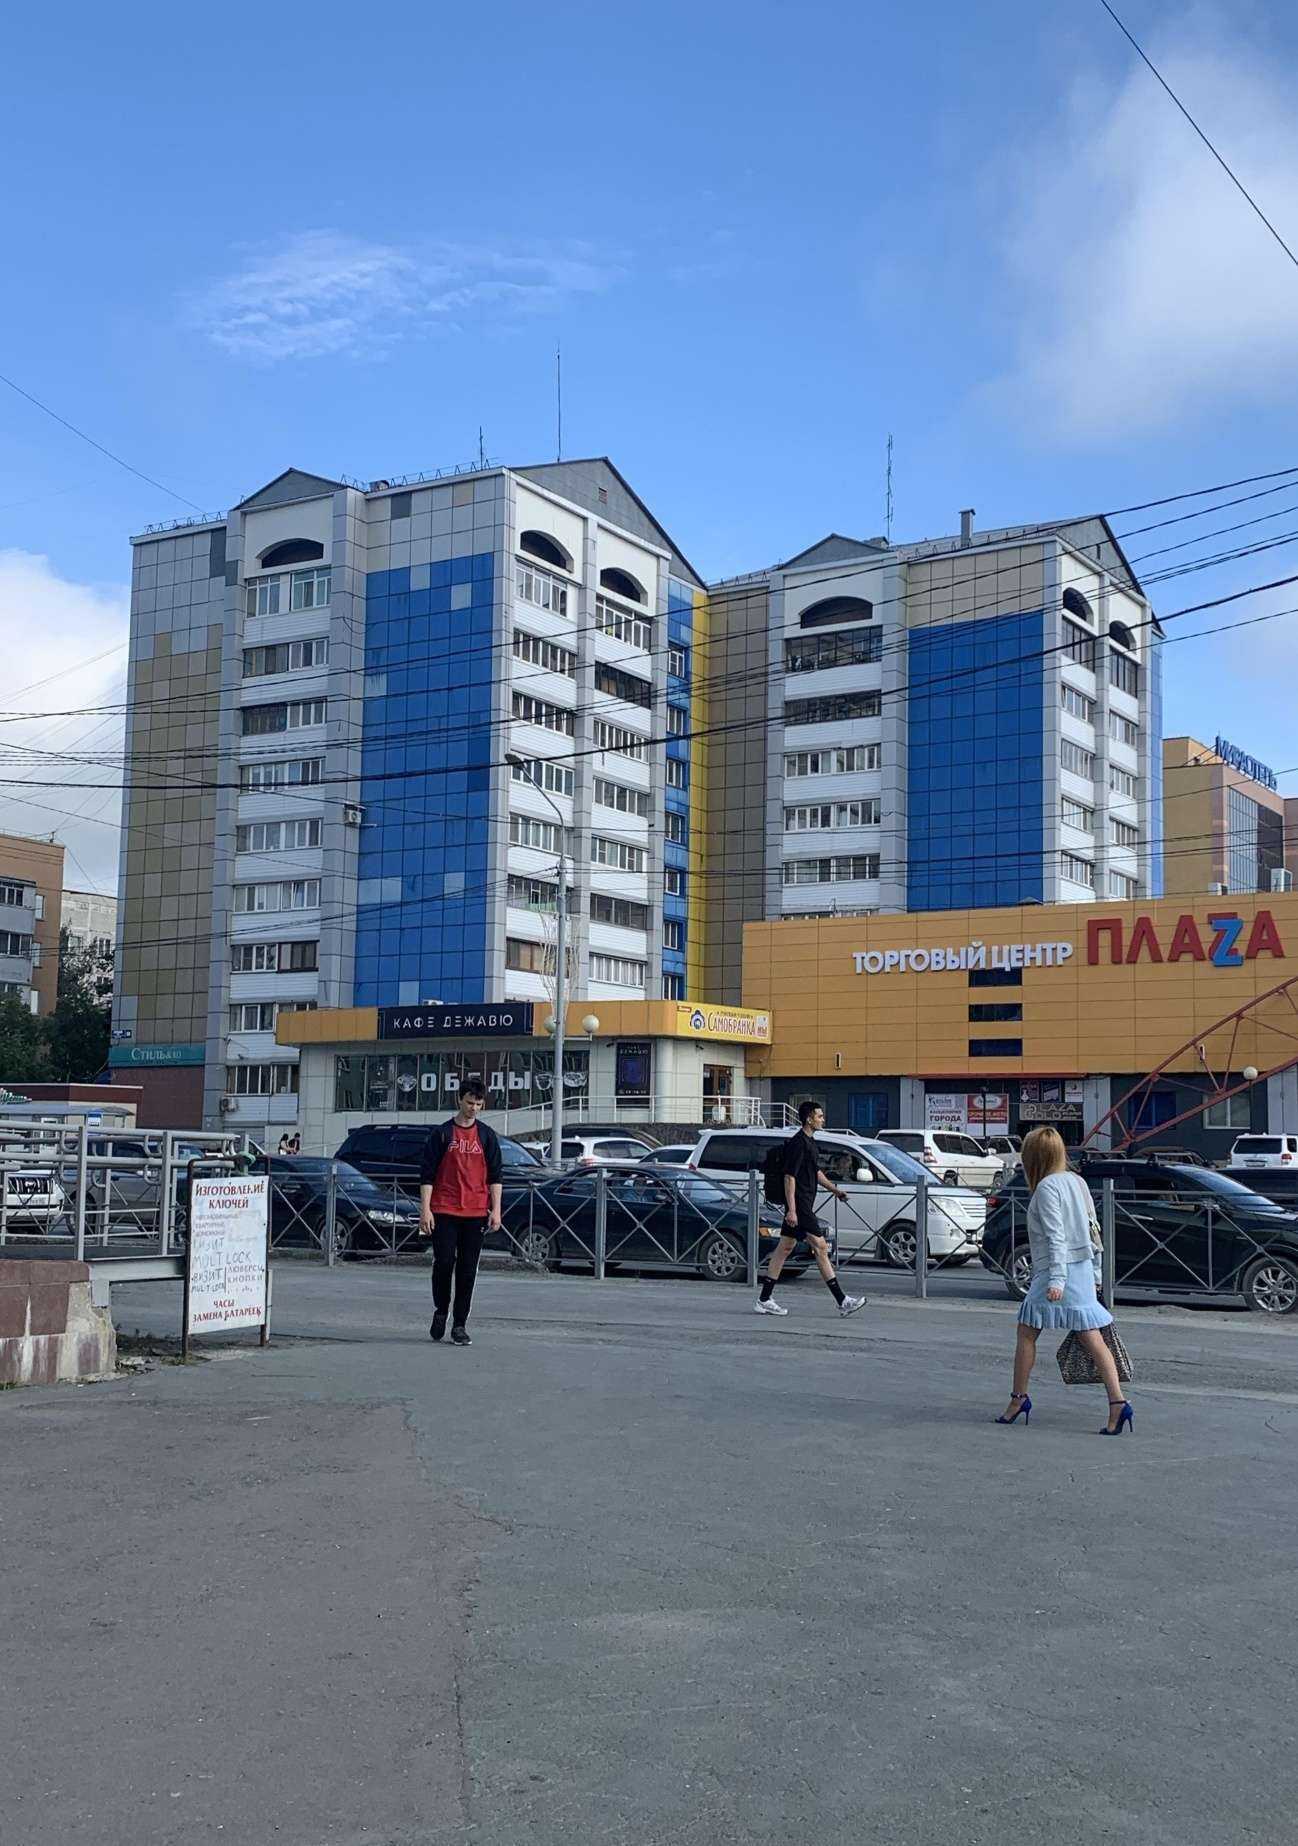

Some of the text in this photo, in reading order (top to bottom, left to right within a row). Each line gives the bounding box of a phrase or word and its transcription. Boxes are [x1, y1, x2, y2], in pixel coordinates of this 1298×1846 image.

[852, 941, 1074, 974] ТОРГОВЫЙ ЦЕНТР
[393, 1014, 513, 1029] КАФЕ ДЕЖАВЮ
[420, 1071, 531, 1093] ОБДЫ
[448, 1139, 483, 1153] FILA
[208, 1197, 249, 1209] КЛЮЧЕЙ
[213, 1299, 234, 1308] ЧАСЫ
[193, 1311, 223, 1322] ЗАМЕНА
